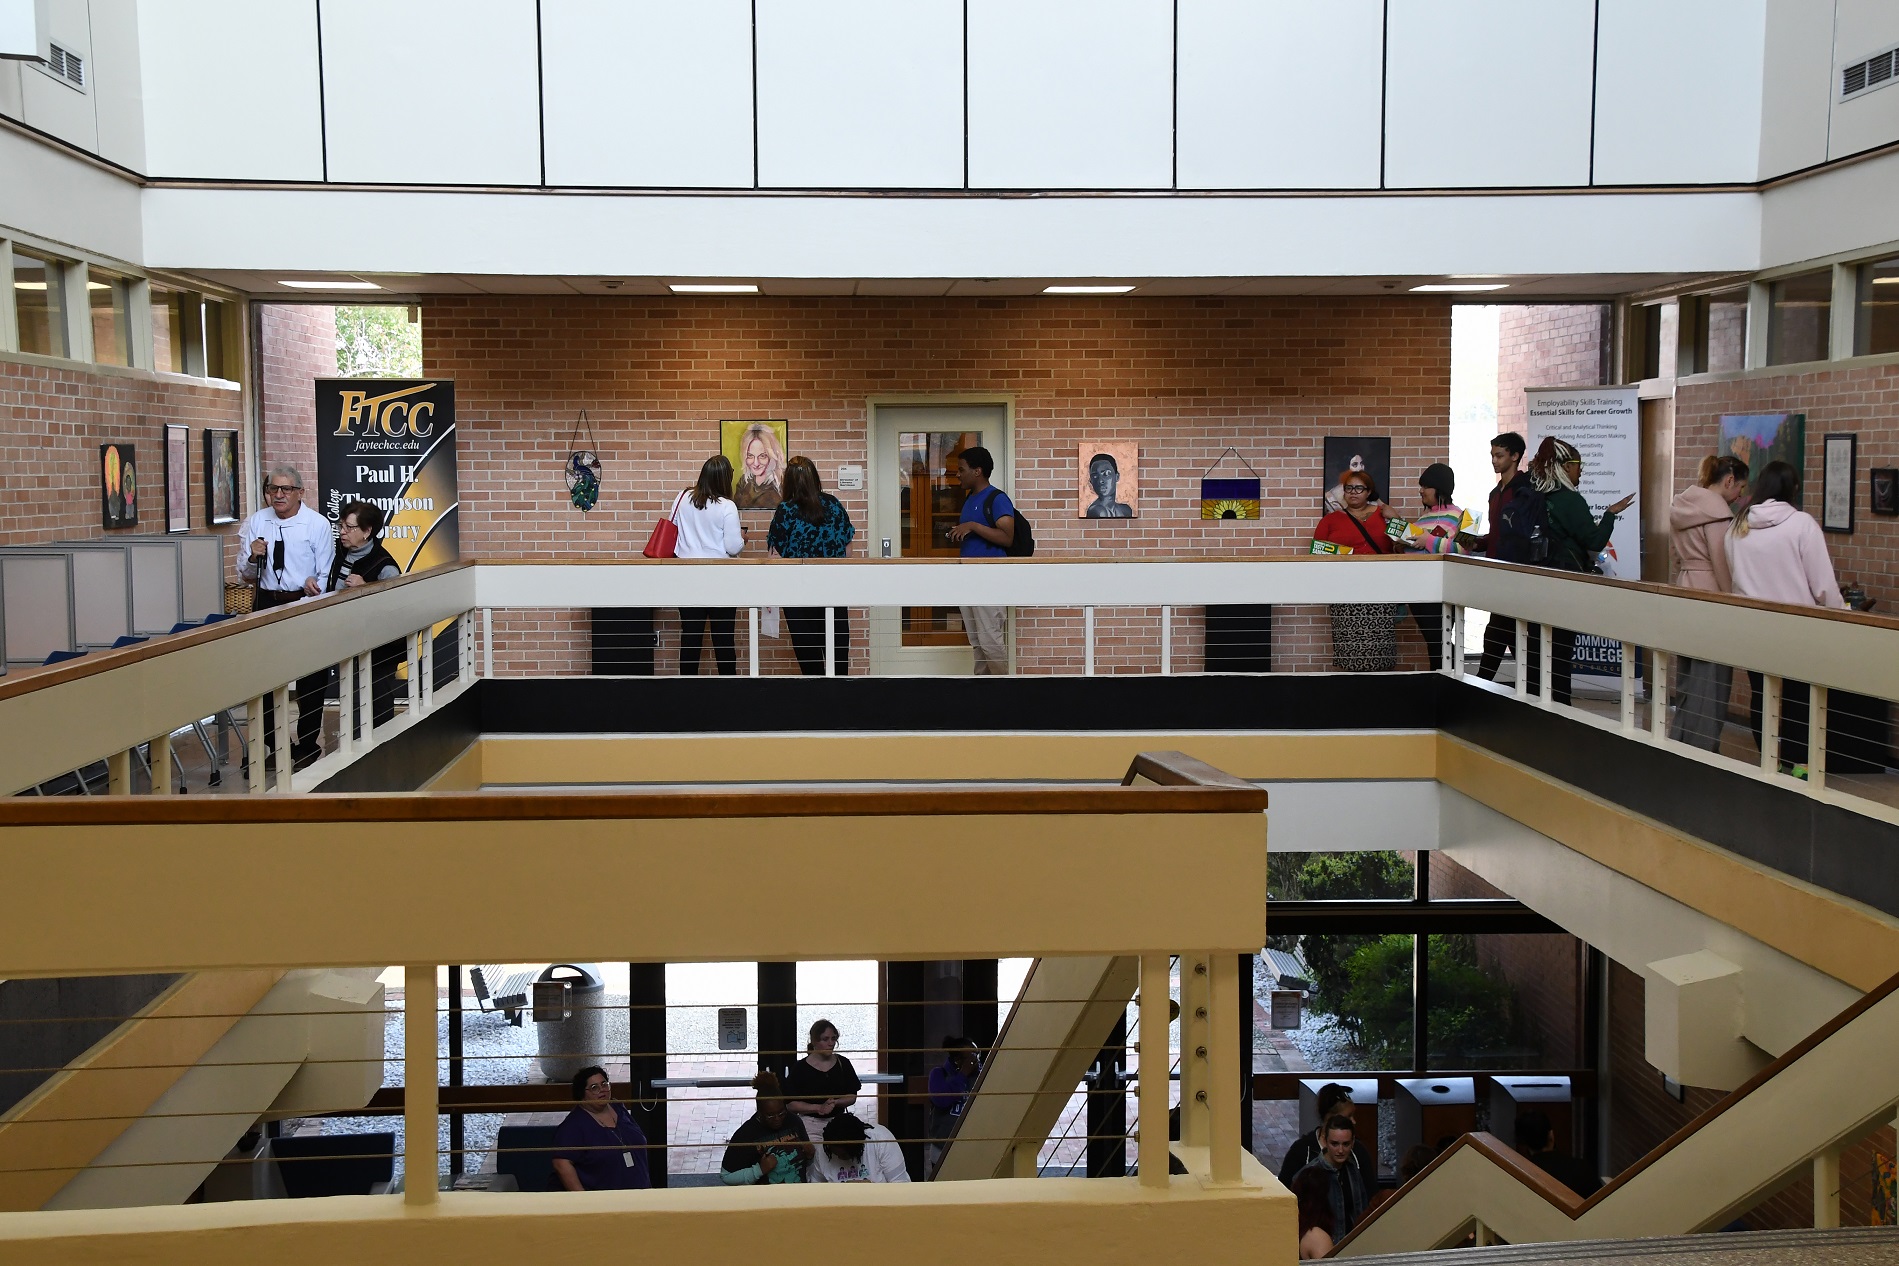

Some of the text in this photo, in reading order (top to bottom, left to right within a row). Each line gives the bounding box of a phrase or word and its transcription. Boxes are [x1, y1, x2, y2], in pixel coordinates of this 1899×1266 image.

[333, 383, 437, 437] FTCC
[1537, 398, 1623, 408] Employability Skills Training
[354, 439, 420, 452] faytechcc.edu
[356, 465, 419, 483] Paul H.
[327, 488, 343, 521] College
[376, 525, 421, 542] rary
[1575, 634, 1622, 648] OMMUNI
[1590, 664, 1621, 672] SUCCE
